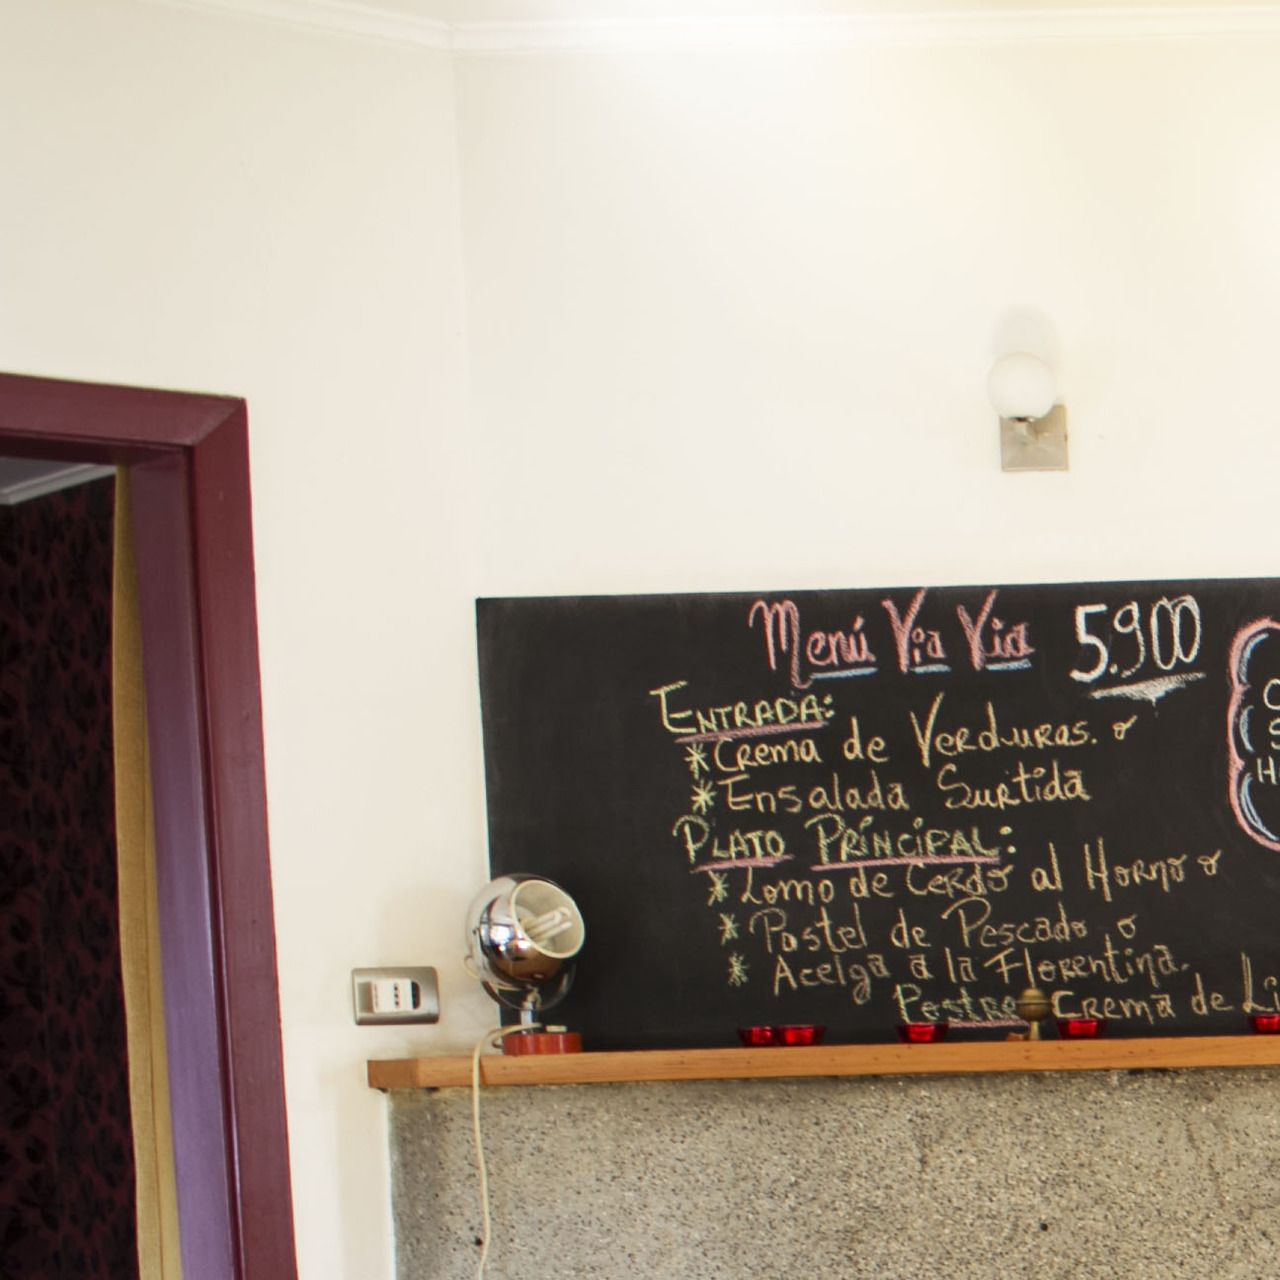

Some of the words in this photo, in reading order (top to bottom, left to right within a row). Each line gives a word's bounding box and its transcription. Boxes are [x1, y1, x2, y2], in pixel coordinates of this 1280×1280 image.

[748, 599, 877, 689] Menú
[881, 586, 947, 674] Via
[957, 589, 1036, 671] Via
[1069, 595, 1201, 682] 5.900
[650, 680, 835, 734] ENTRADA:
[844, 716, 889, 763] de
[672, 815, 786, 864] PLATO
[741, 864, 835, 906] Lomo
[850, 863, 895, 898] de
[1031, 842, 1063, 892] al
[890, 907, 931, 949] de
[944, 947, 977, 983] la
[1191, 972, 1234, 1016] de
